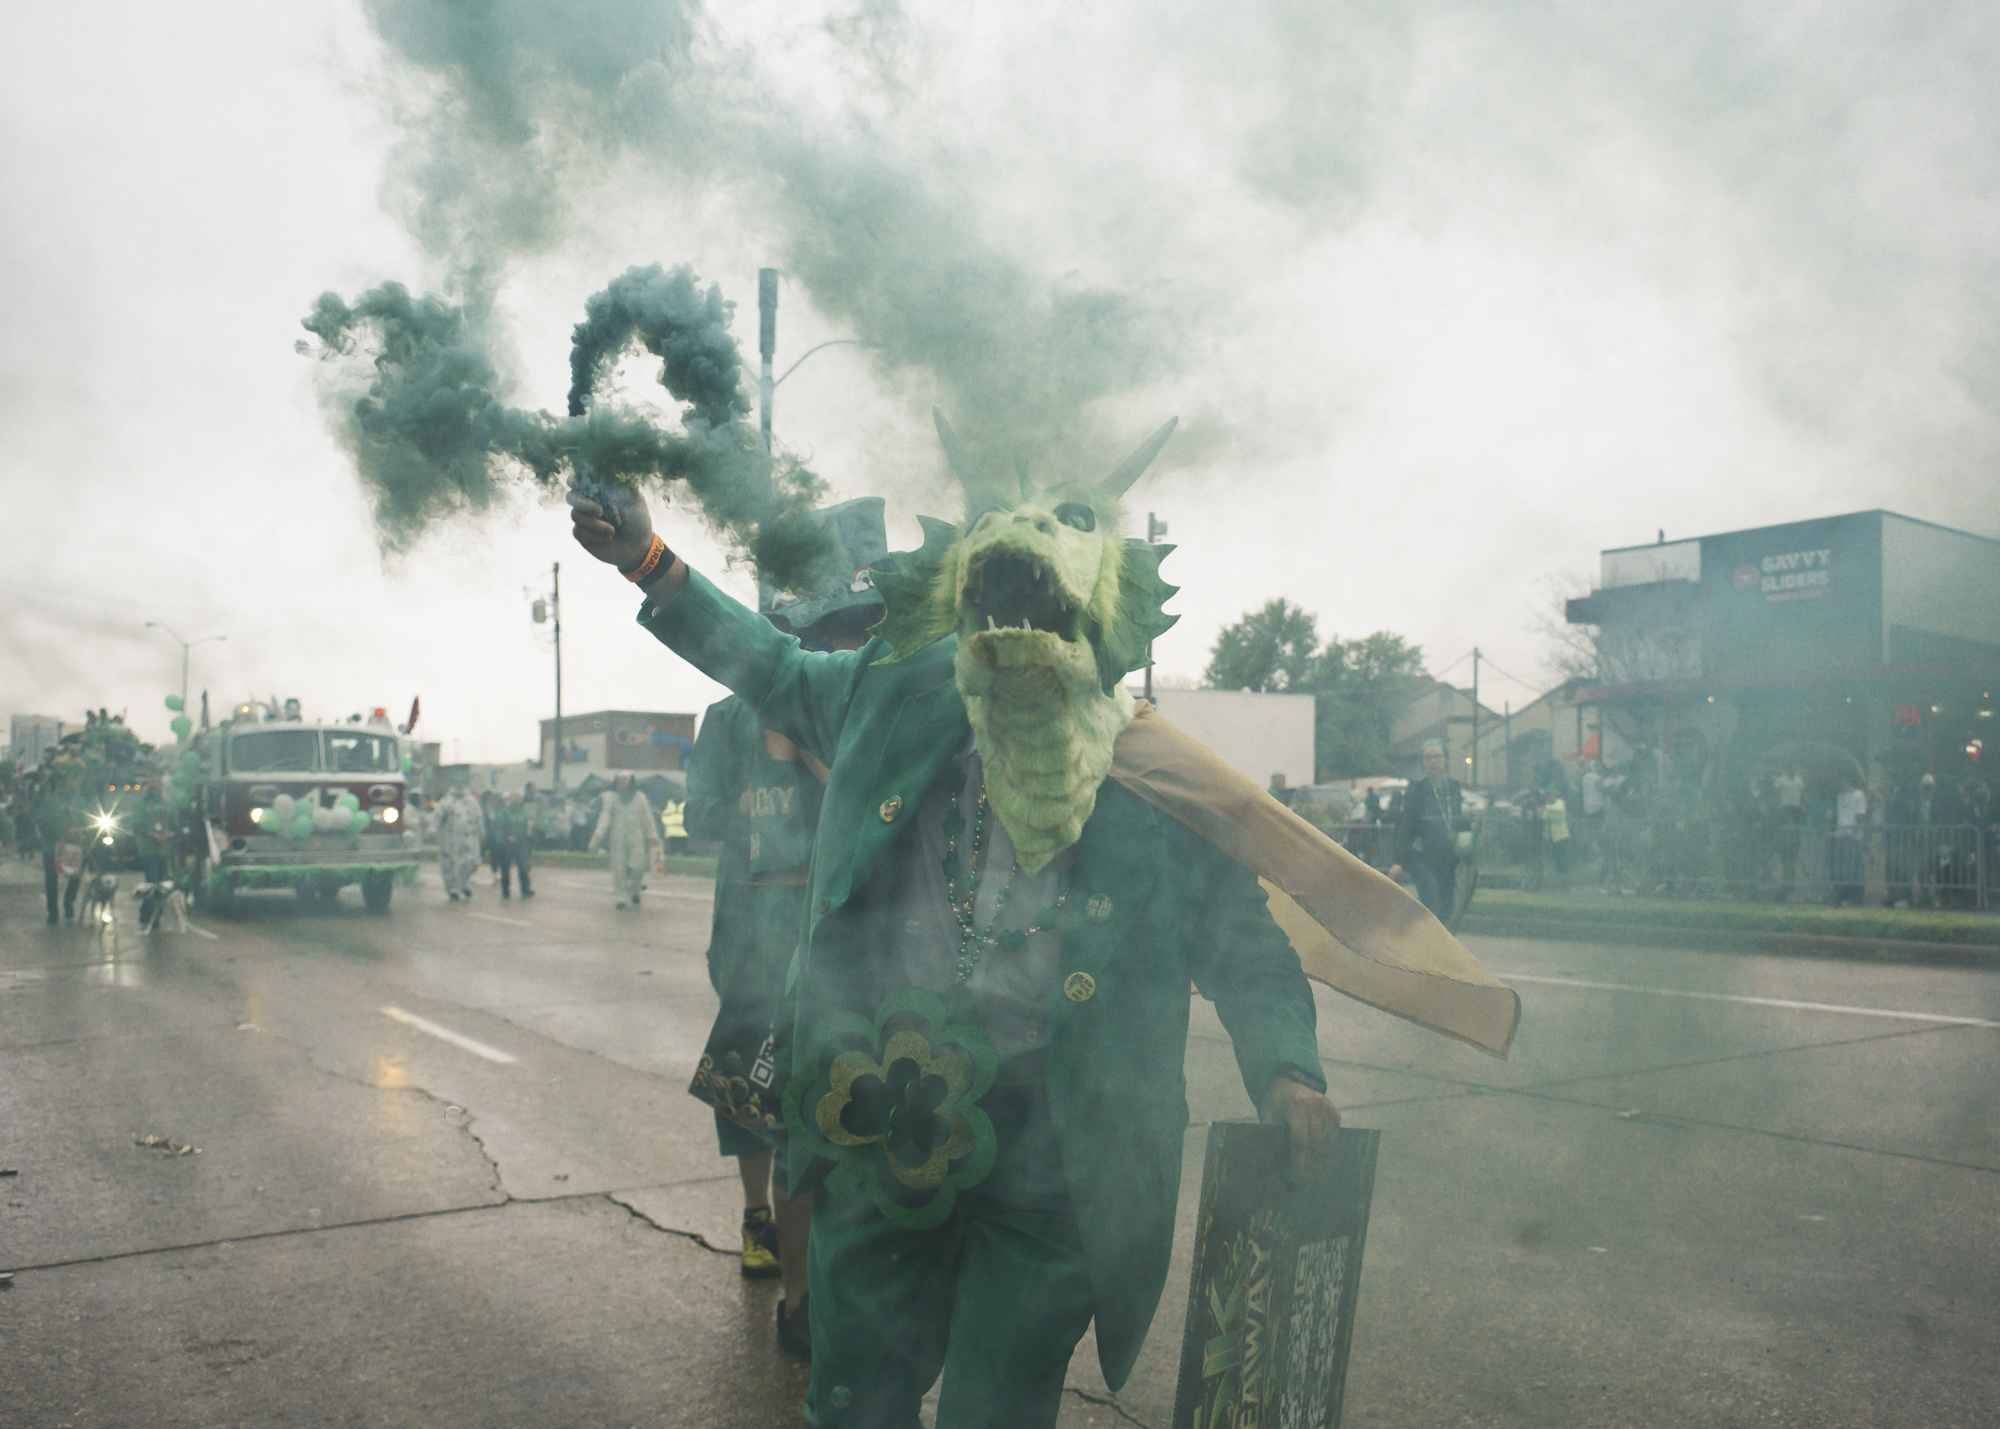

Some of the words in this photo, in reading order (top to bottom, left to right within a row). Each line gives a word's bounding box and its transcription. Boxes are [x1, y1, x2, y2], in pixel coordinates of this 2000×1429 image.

[637, 540, 664, 577] PARADE
[1761, 549, 1832, 572] SAVVY
[1760, 569, 1830, 592] SLIDERS
